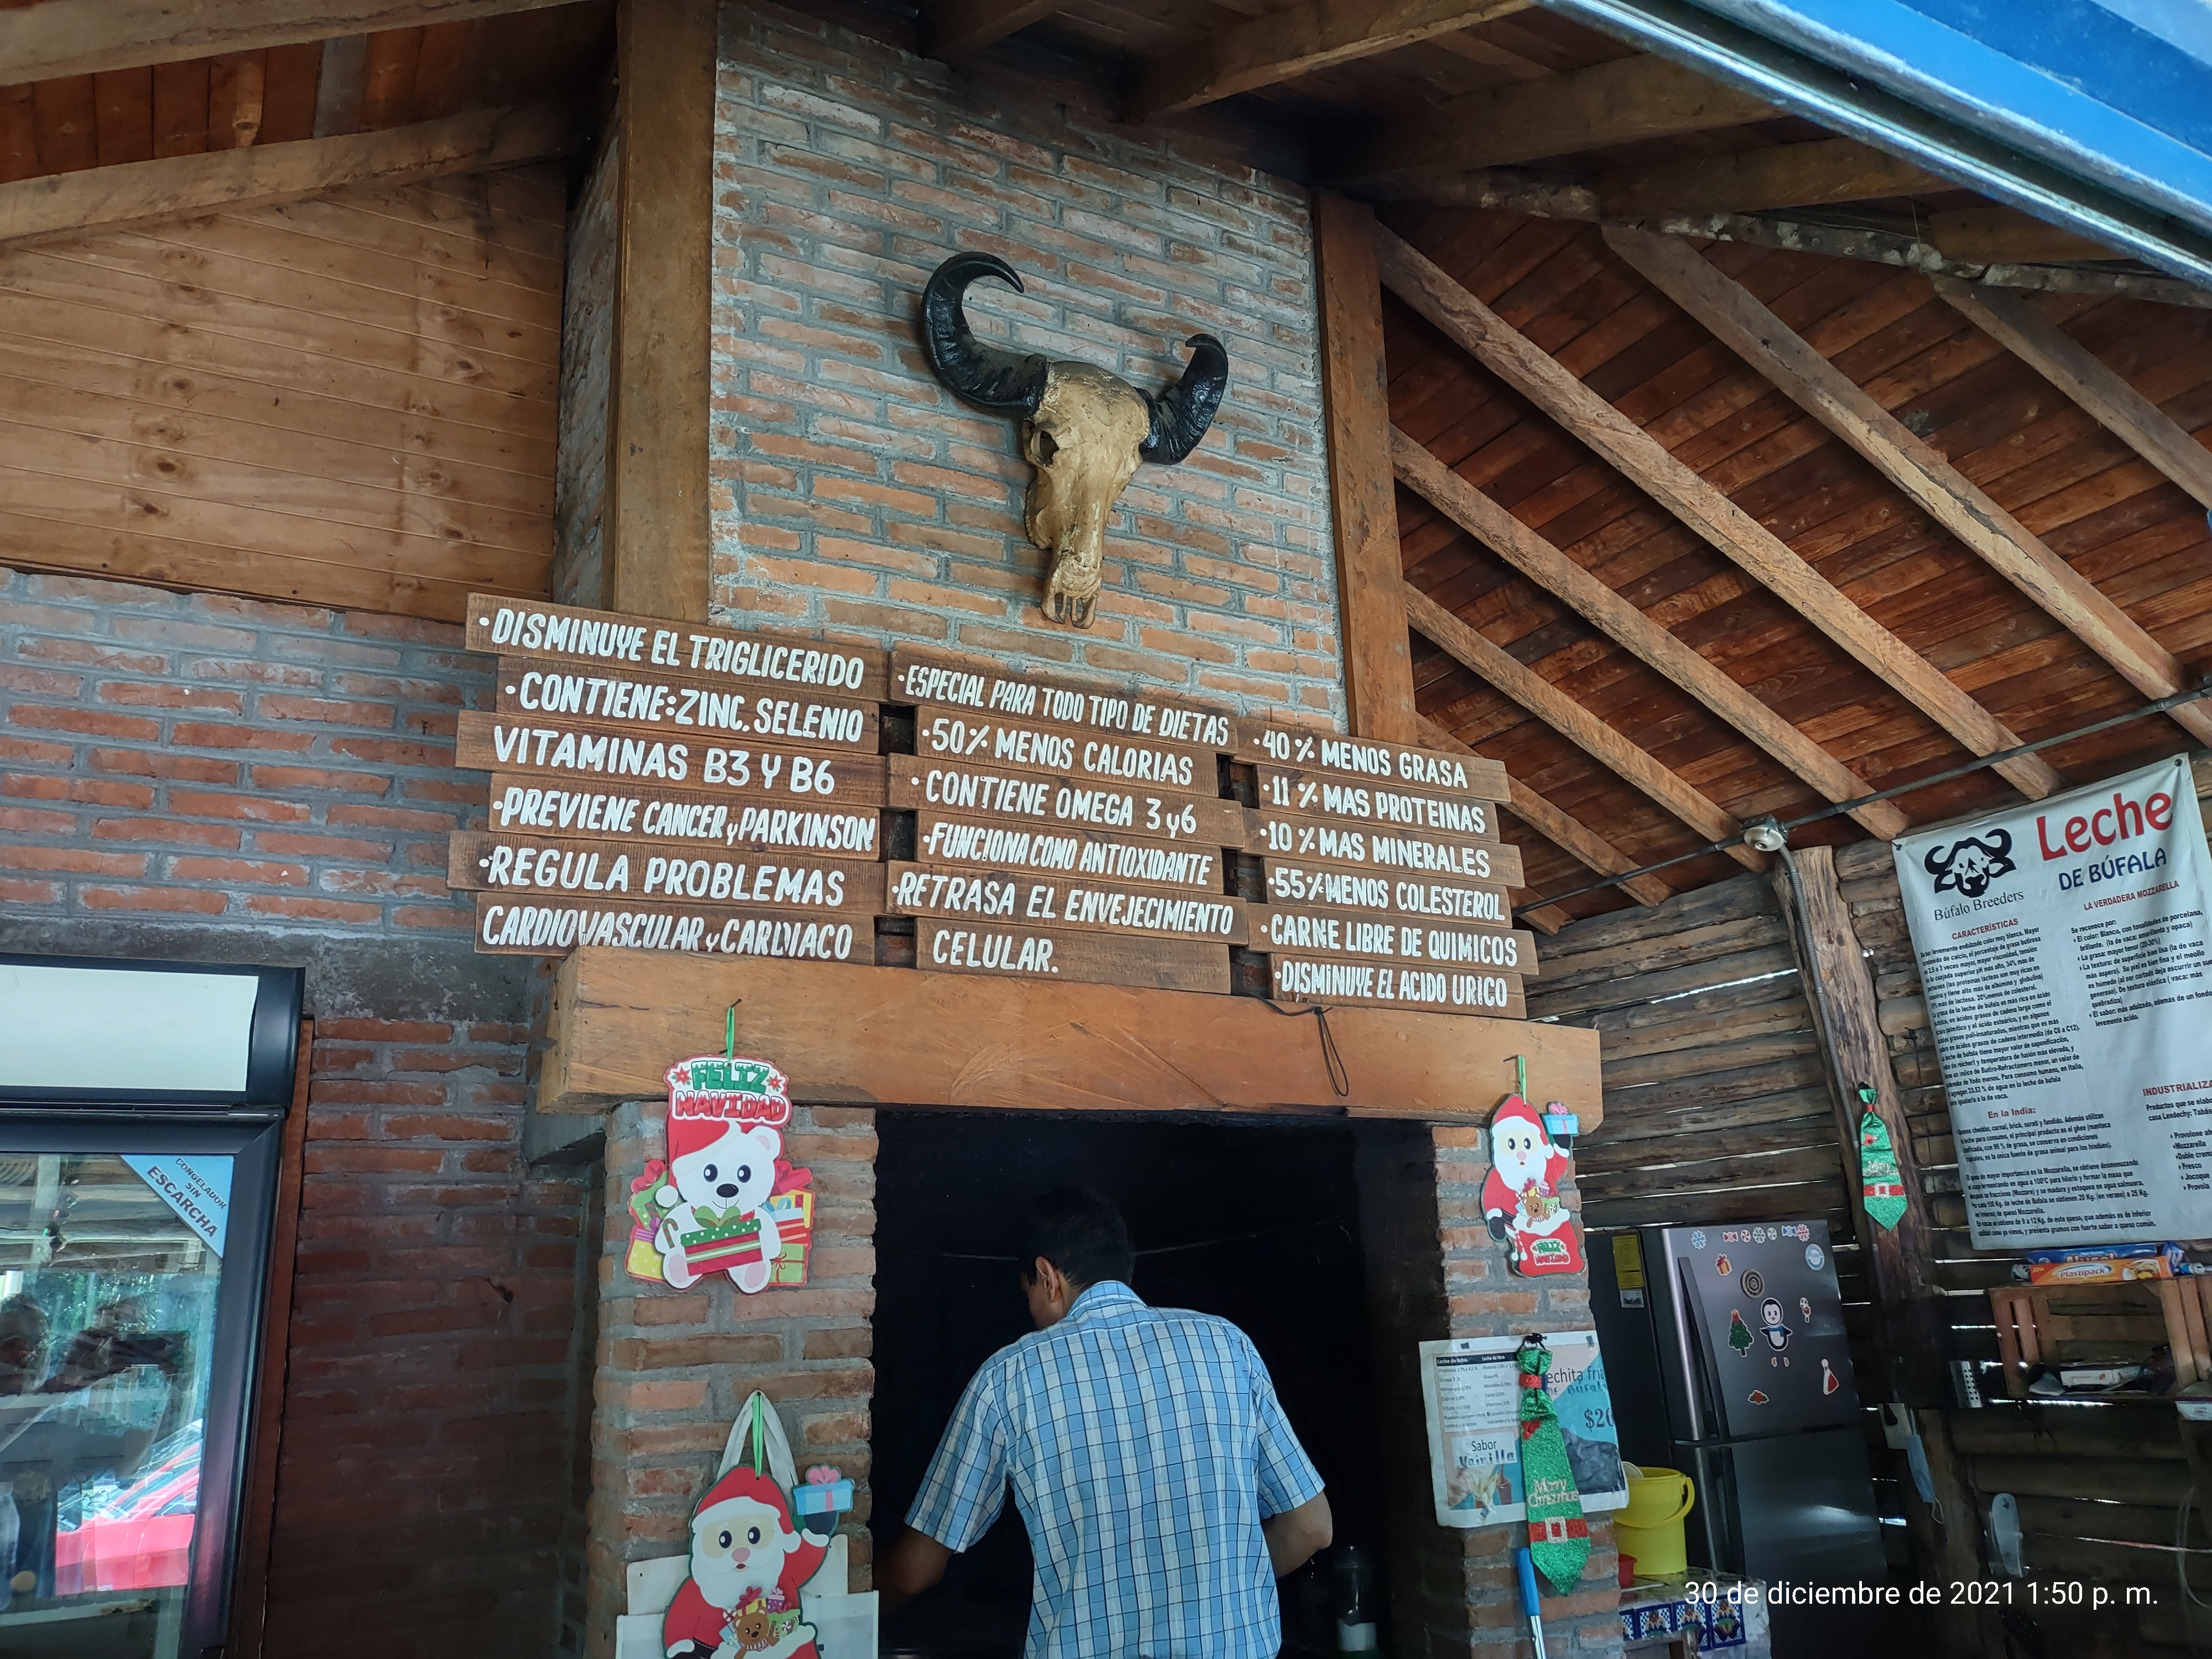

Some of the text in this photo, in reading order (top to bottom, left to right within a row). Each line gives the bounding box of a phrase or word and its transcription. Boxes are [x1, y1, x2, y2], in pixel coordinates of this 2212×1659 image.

[492, 608, 864, 689] DISMINUYE EL TRIGLICERIDO
[754, 698, 863, 742] SELENIO
[906, 665, 1229, 745] ESPECIAL PARA TODO TIPO DE DIETAS
[494, 726, 687, 780] VITAMINAS
[704, 748, 750, 786] B3
[790, 757, 834, 795] B6
[931, 718, 1193, 785] 50% MENOS CALORIAS
[1322, 739, 1391, 776] MENOS
[1399, 753, 1468, 789] GRASA
[501, 787, 639, 833] PREVIENE
[643, 802, 729, 839] CANCER
[739, 809, 875, 851] PARKINSON
[926, 770, 1048, 816] CONTIENE
[1056, 788, 1133, 827] OMEGA
[1146, 799, 1161, 830] 3
[1323, 784, 1370, 816] MAS
[1376, 792, 1485, 833] PROTEINAS
[2036, 792, 2173, 861] Leche
[927, 822, 1213, 885] FUNCIONA COMO ANTIOXIDANTE
[1319, 828, 1365, 861] MAS
[1373, 836, 1490, 878] MINERALES
[2059, 847, 2167, 890] DE BÚFALA
[488, 846, 845, 906] REGULA PROBLEMAS
[2083, 880, 2179, 910] LA VERDADERA MOZZARELLA
[898, 872, 1233, 935] RETRASA EL ENVEJECIMIENTO
[1326, 873, 1389, 909] MENOS
[1397, 881, 1505, 921] COLESTEROL
[1934, 890, 2025, 921] Búfalo Breeders
[484, 906, 704, 951] CARDIOVASCULAR
[721, 919, 852, 959] CARDIACO
[1272, 914, 1517, 967] CARNE LIBRE DE QUIMICOS
[1952, 918, 2019, 940] CARACTERÍSTICAS
[2080, 923, 2104, 931] reconoce
[2100, 929, 2121, 937] Blanco,
[2133, 919, 2161, 930] tonalidades
[2170, 910, 2203, 921] porcelana,
[2171, 921, 2193, 930] opaca)
[933, 930, 1058, 973] CELULAR.
[1932, 946, 1958, 954] levemente
[2090, 952, 2106, 961] grasa:
[2107, 948, 2124, 957] mayor
[1282, 961, 1507, 1006] DISMINUYE EL ACIDO URICO
[691, 1060, 769, 1093] FELIZ
[675, 1090, 786, 1121] NAVIDAD
[2012, 1107, 2036, 1115] India:
[2146, 1102, 2174, 1111] Productos
[2163, 1110, 2192, 1119] Lendechy:
[2174, 1129, 2203, 1139] Provolone
[2175, 1140, 2206, 1150] Mozzarella
[2178, 1151, 2194, 1160] Doble
[176, 1157, 227, 1209] CONGELADOR
[185, 1182, 201, 1198] SIN
[2185, 1172, 2210, 1181] Jocoque
[2188, 1182, 2210, 1191] Provola
[147, 1165, 218, 1238] ESCARCHA
[2060, 1266, 2106, 1278] Plastipack
[1547, 1368, 1583, 1383] echita
[1472, 1439, 1497, 1451] Sabor
